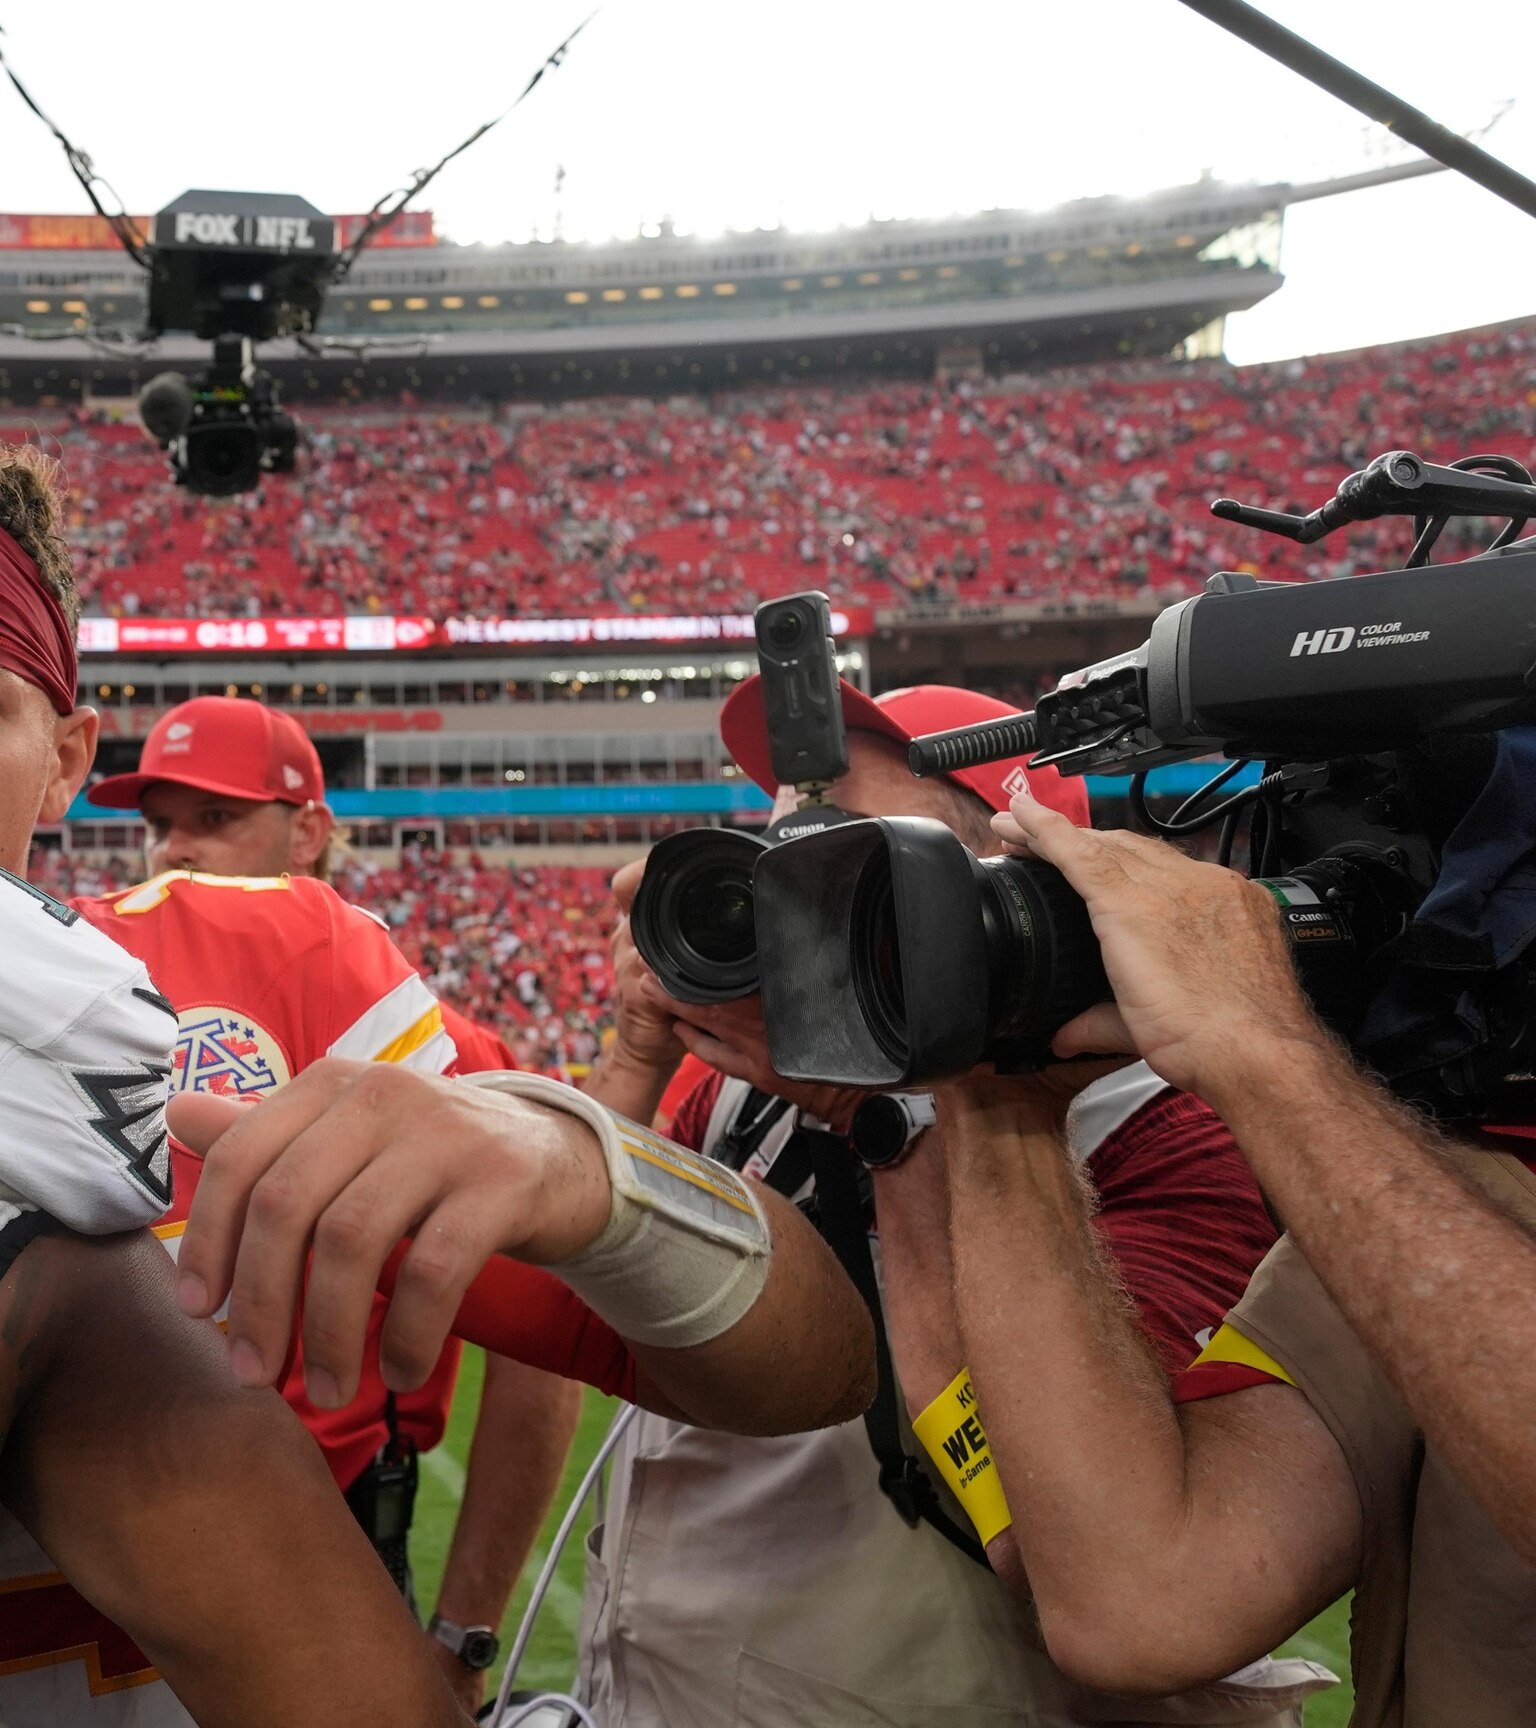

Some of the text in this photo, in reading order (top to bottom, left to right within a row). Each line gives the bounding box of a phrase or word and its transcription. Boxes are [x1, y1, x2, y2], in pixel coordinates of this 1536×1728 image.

[175, 213, 240, 245] FOX
[256, 215, 315, 248] NFL
[1289, 621, 1402, 658] HD COLOR
[1356, 630, 1430, 649] VIEWFINDER
[778, 822, 825, 839] Canon
[1019, 911, 1031, 937] CANON
[1288, 913, 1332, 922] Canon
[942, 1409, 987, 1470] WE
